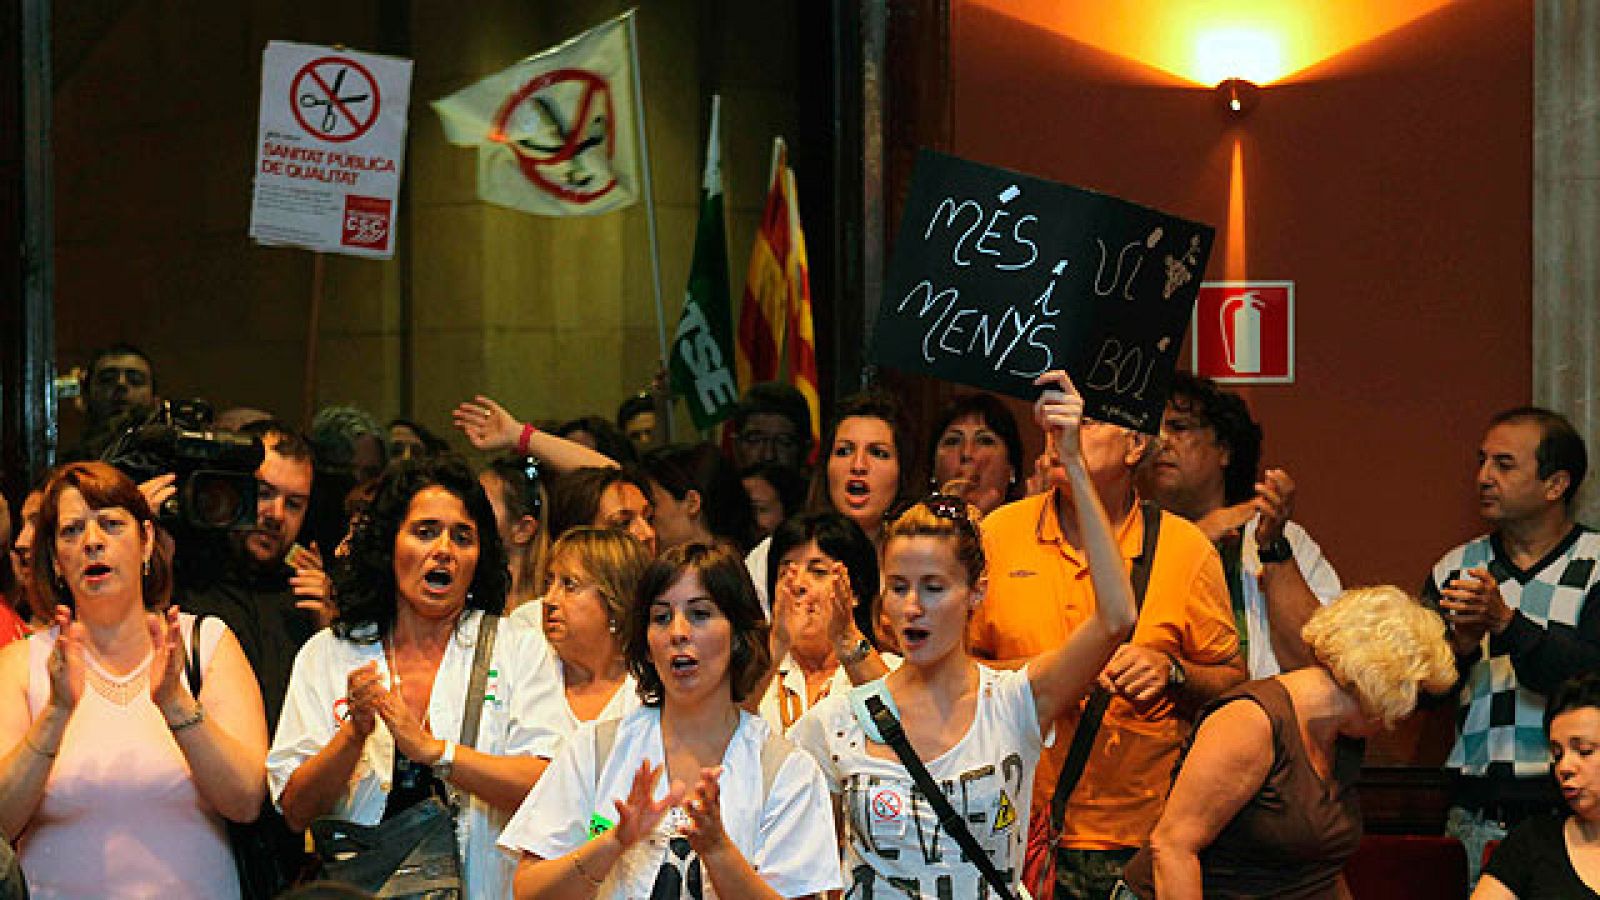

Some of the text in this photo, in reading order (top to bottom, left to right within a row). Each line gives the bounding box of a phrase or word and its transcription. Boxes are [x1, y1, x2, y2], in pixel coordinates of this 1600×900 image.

[261, 159, 360, 185] DE QUALITAT
[263, 141, 325, 164] SANITAT
[925, 184, 1038, 270] MÉS
[897, 279, 1056, 378] MENYS
